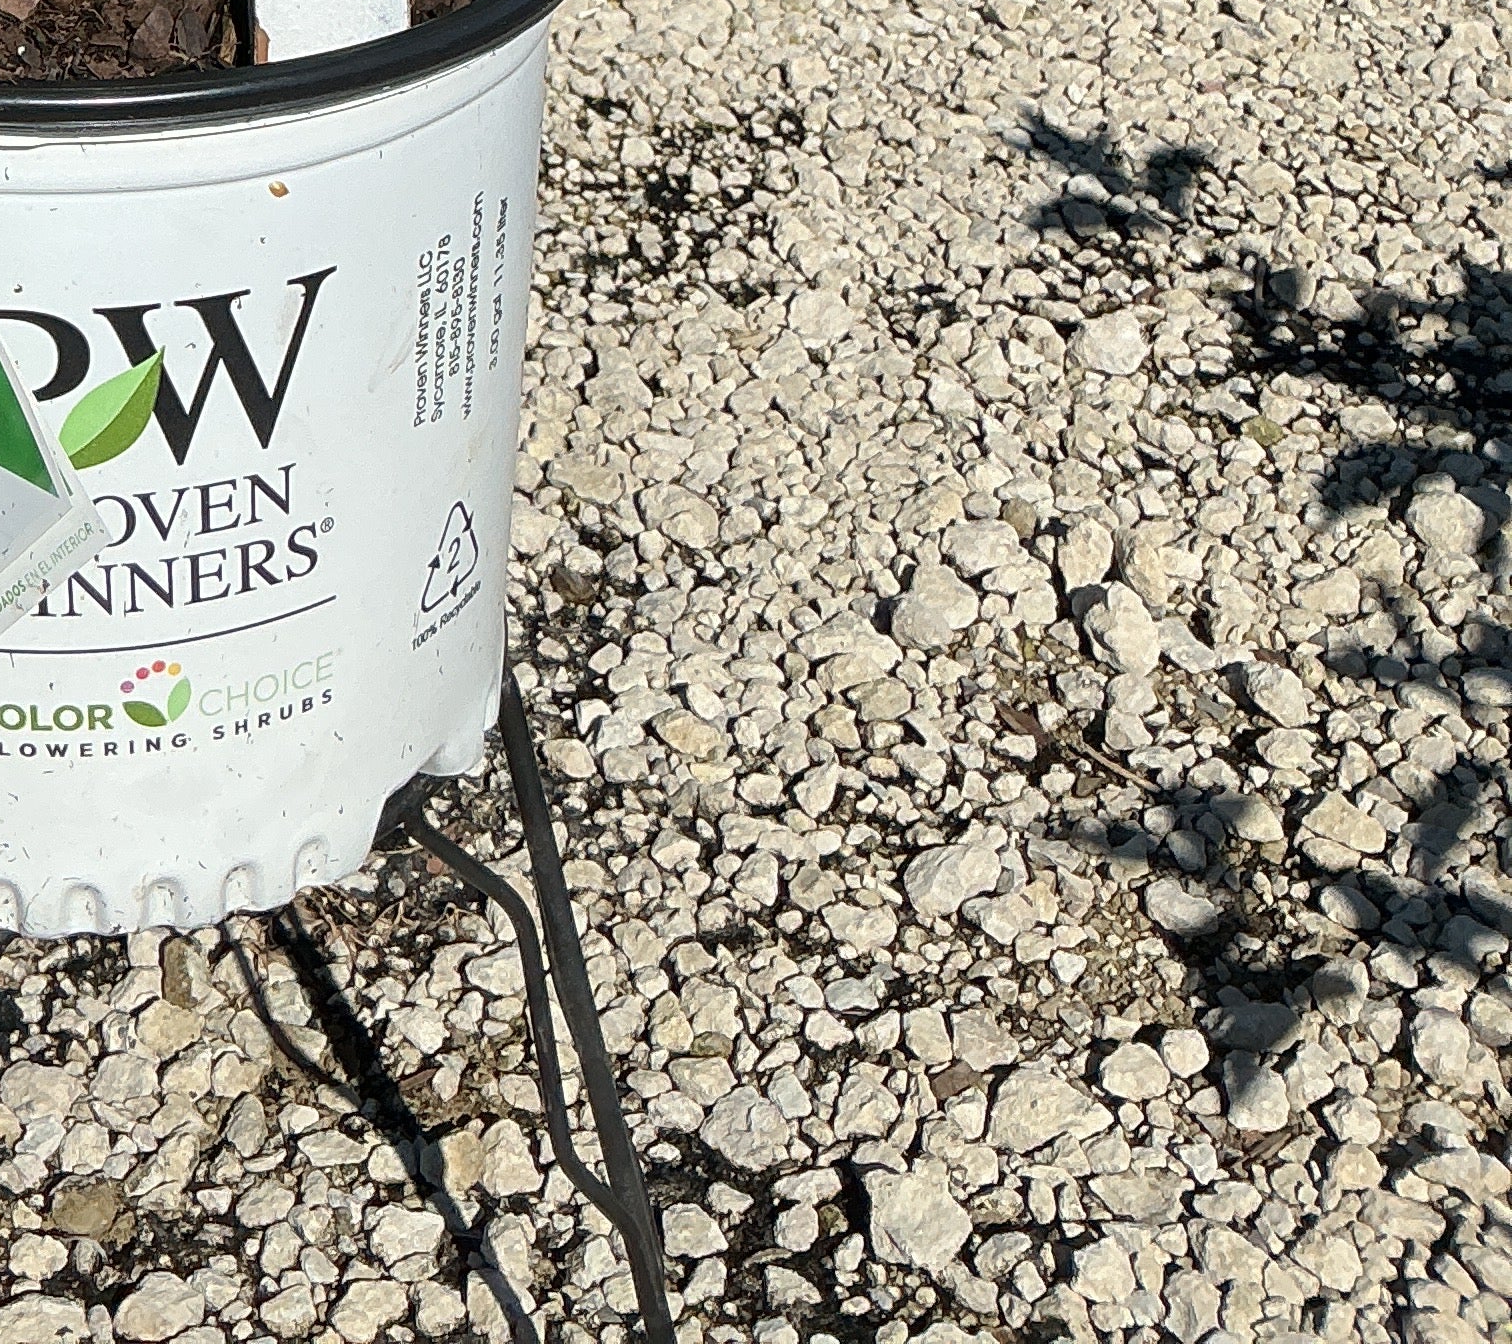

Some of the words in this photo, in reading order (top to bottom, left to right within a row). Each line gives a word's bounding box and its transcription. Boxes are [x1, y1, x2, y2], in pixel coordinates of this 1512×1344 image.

[416, 250, 433, 288] LLC
[434, 233, 451, 294] 60178
[414, 287, 431, 363] Winners
[433, 301, 448, 321] IL
[448, 256, 465, 378] 815-895-8130
[460, 190, 485, 421] www.provenwinners.com
[488, 327, 500, 371] 3.00
[413, 361, 428, 428] Proven
[24, 570, 41, 587] EN
[37, 559, 53, 577] EL
[49, 521, 96, 566] INTERIOR
[446, 536, 461, 574] 2
[411, 621, 438, 652] 100%
[198, 650, 334, 717] CHOICE
[212, 688, 333, 741] SHRUBS
